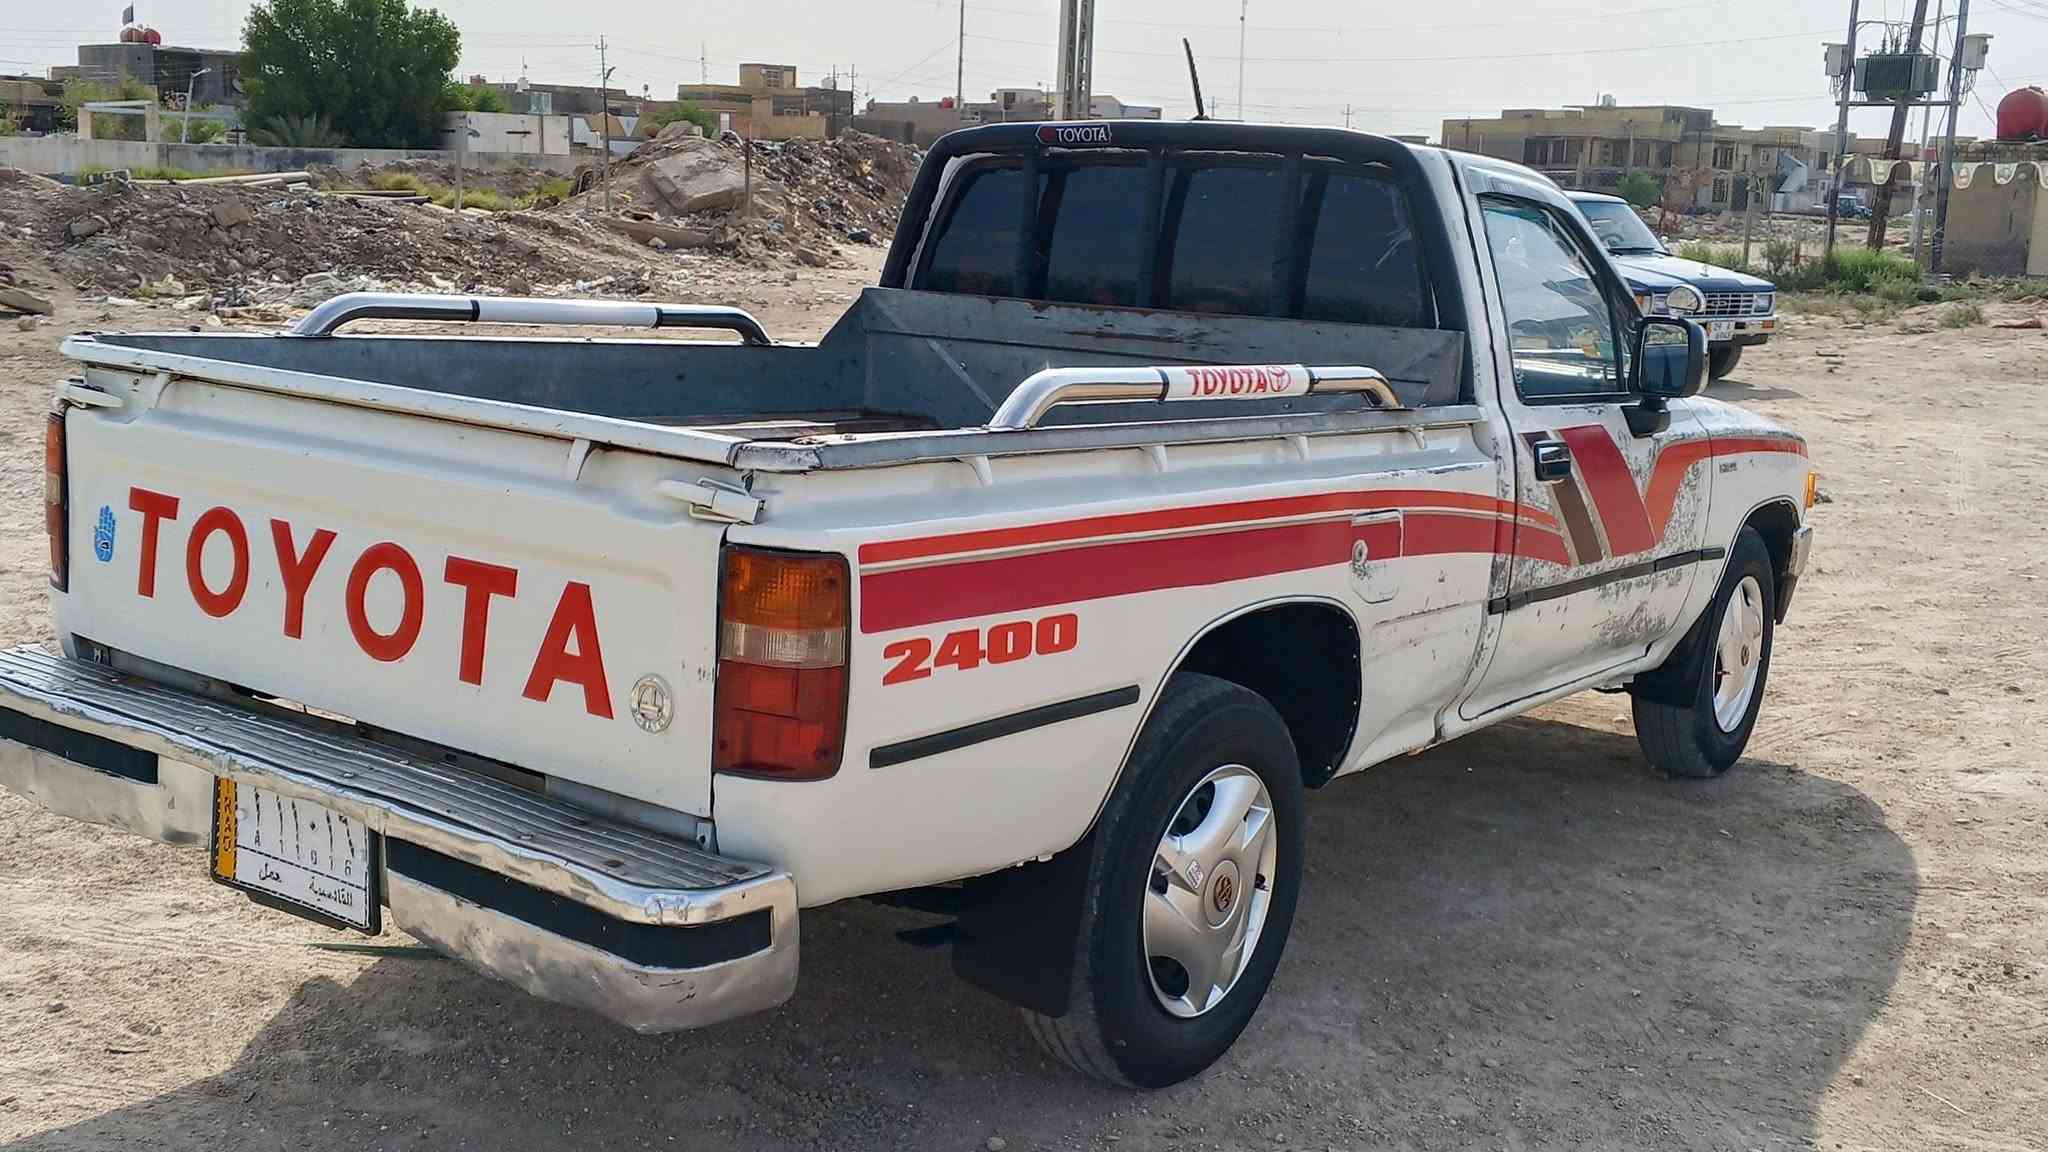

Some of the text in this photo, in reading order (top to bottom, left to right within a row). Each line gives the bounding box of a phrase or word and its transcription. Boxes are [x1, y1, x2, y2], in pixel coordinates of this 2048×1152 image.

[1056, 126, 1108, 143] TOYOTA
[1186, 368, 1267, 395] TOYOTA
[129, 487, 615, 720] TOYOTA
[882, 613, 1079, 686] 2400
